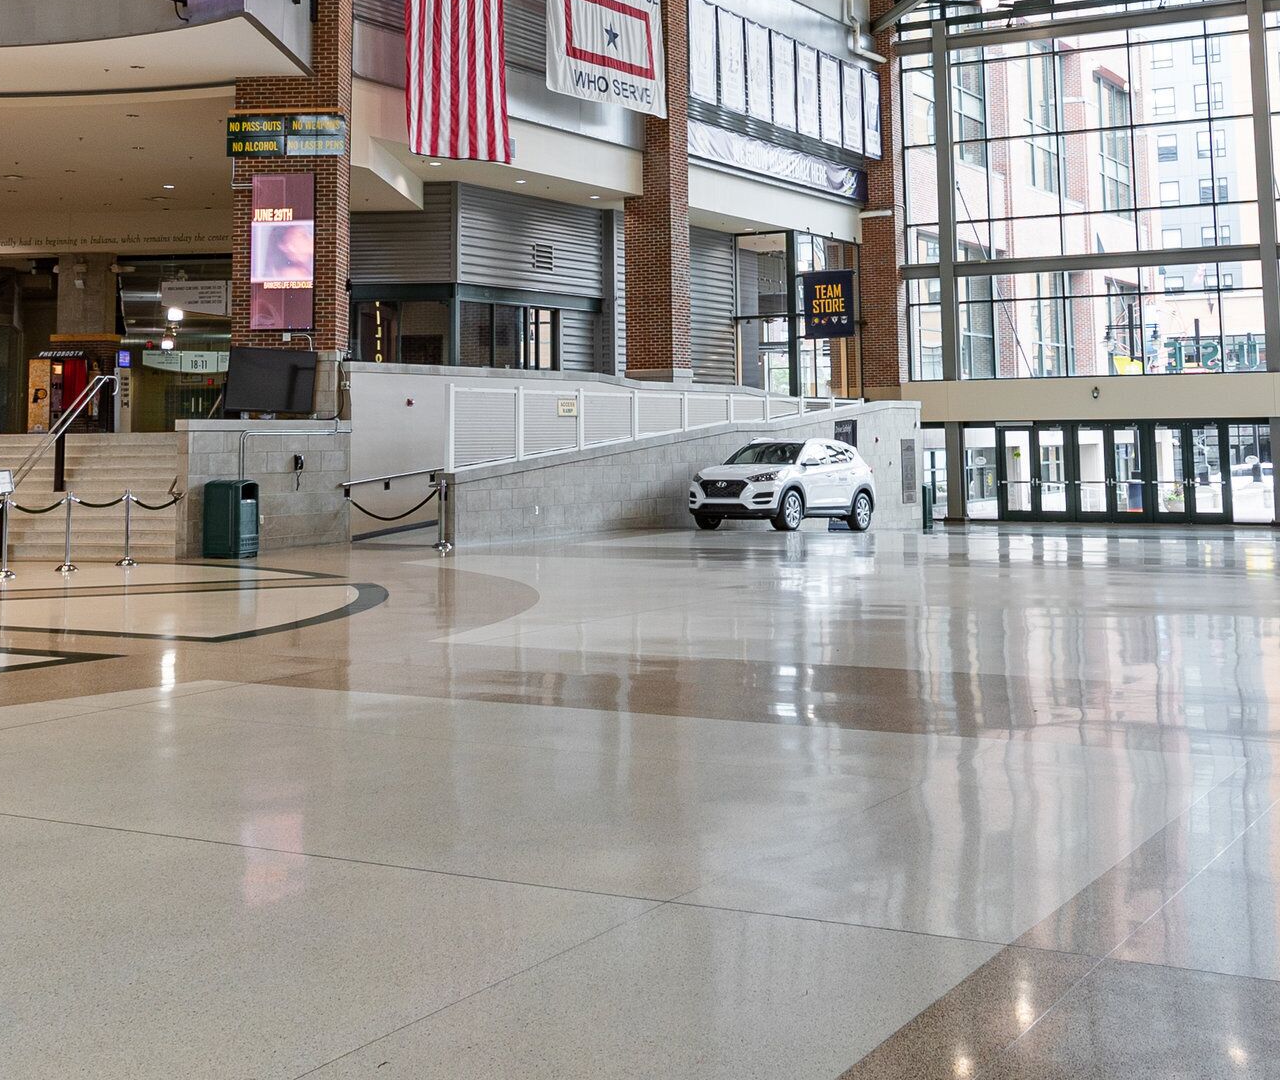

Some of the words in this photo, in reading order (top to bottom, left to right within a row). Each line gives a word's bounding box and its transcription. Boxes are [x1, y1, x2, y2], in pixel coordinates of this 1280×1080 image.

[574, 68, 609, 94] WHO
[612, 78, 652, 105] SERVE
[229, 121, 240, 132] NO
[241, 121, 282, 132] PASS-OUTS
[292, 120, 303, 131] NO
[232, 141, 243, 152] NO
[244, 140, 279, 152] ALCOHOL
[253, 208, 273, 222] JUNE
[273, 208, 293, 221] 29TH
[45, 236, 78, 247] beginning
[120, 233, 141, 244] which
[143, 234, 172, 243] remains
[173, 232, 192, 244] today
[194, 232, 206, 242] the
[207, 233, 229, 242] center
[814, 283, 842, 299] TEAM
[812, 298, 846, 314] STORE
[38, 350, 84, 358] PHOTOBOOTH
